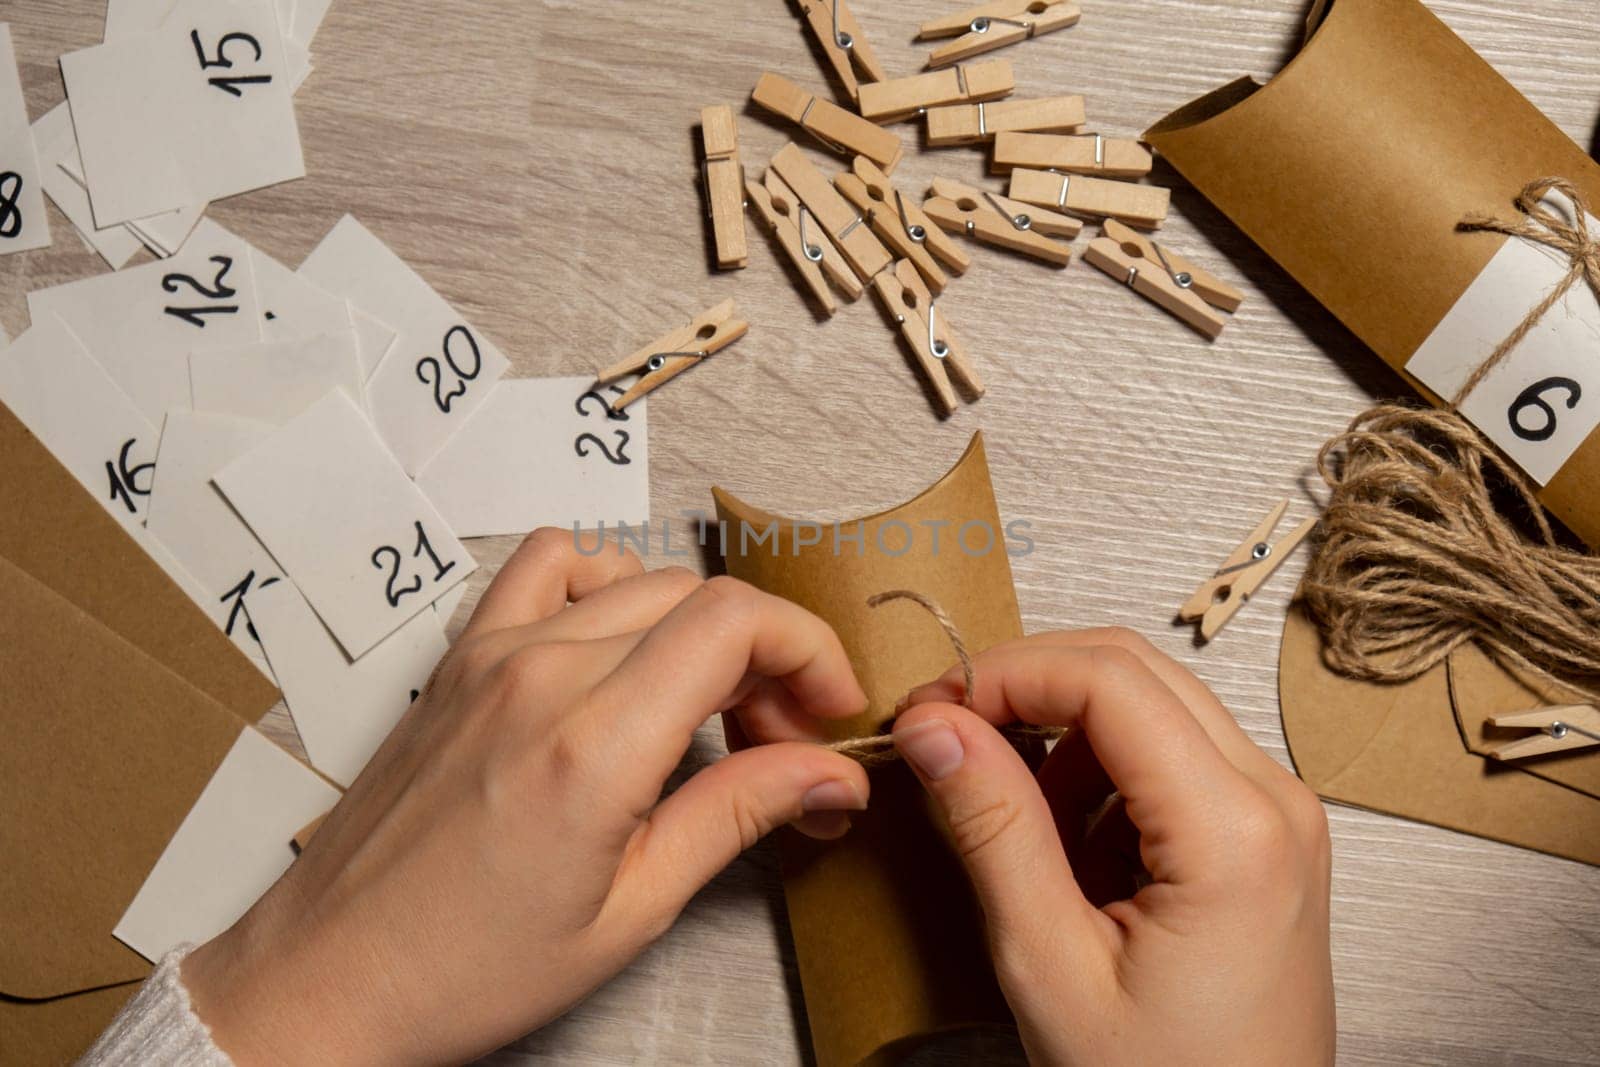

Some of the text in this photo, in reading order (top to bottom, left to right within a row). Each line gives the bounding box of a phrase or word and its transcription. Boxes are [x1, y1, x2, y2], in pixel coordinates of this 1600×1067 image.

[191, 29, 272, 97] 15
[161, 255, 239, 328] 12
[416, 325, 481, 413] 20
[1508, 376, 1582, 441] 6
[372, 521, 455, 607] 21
